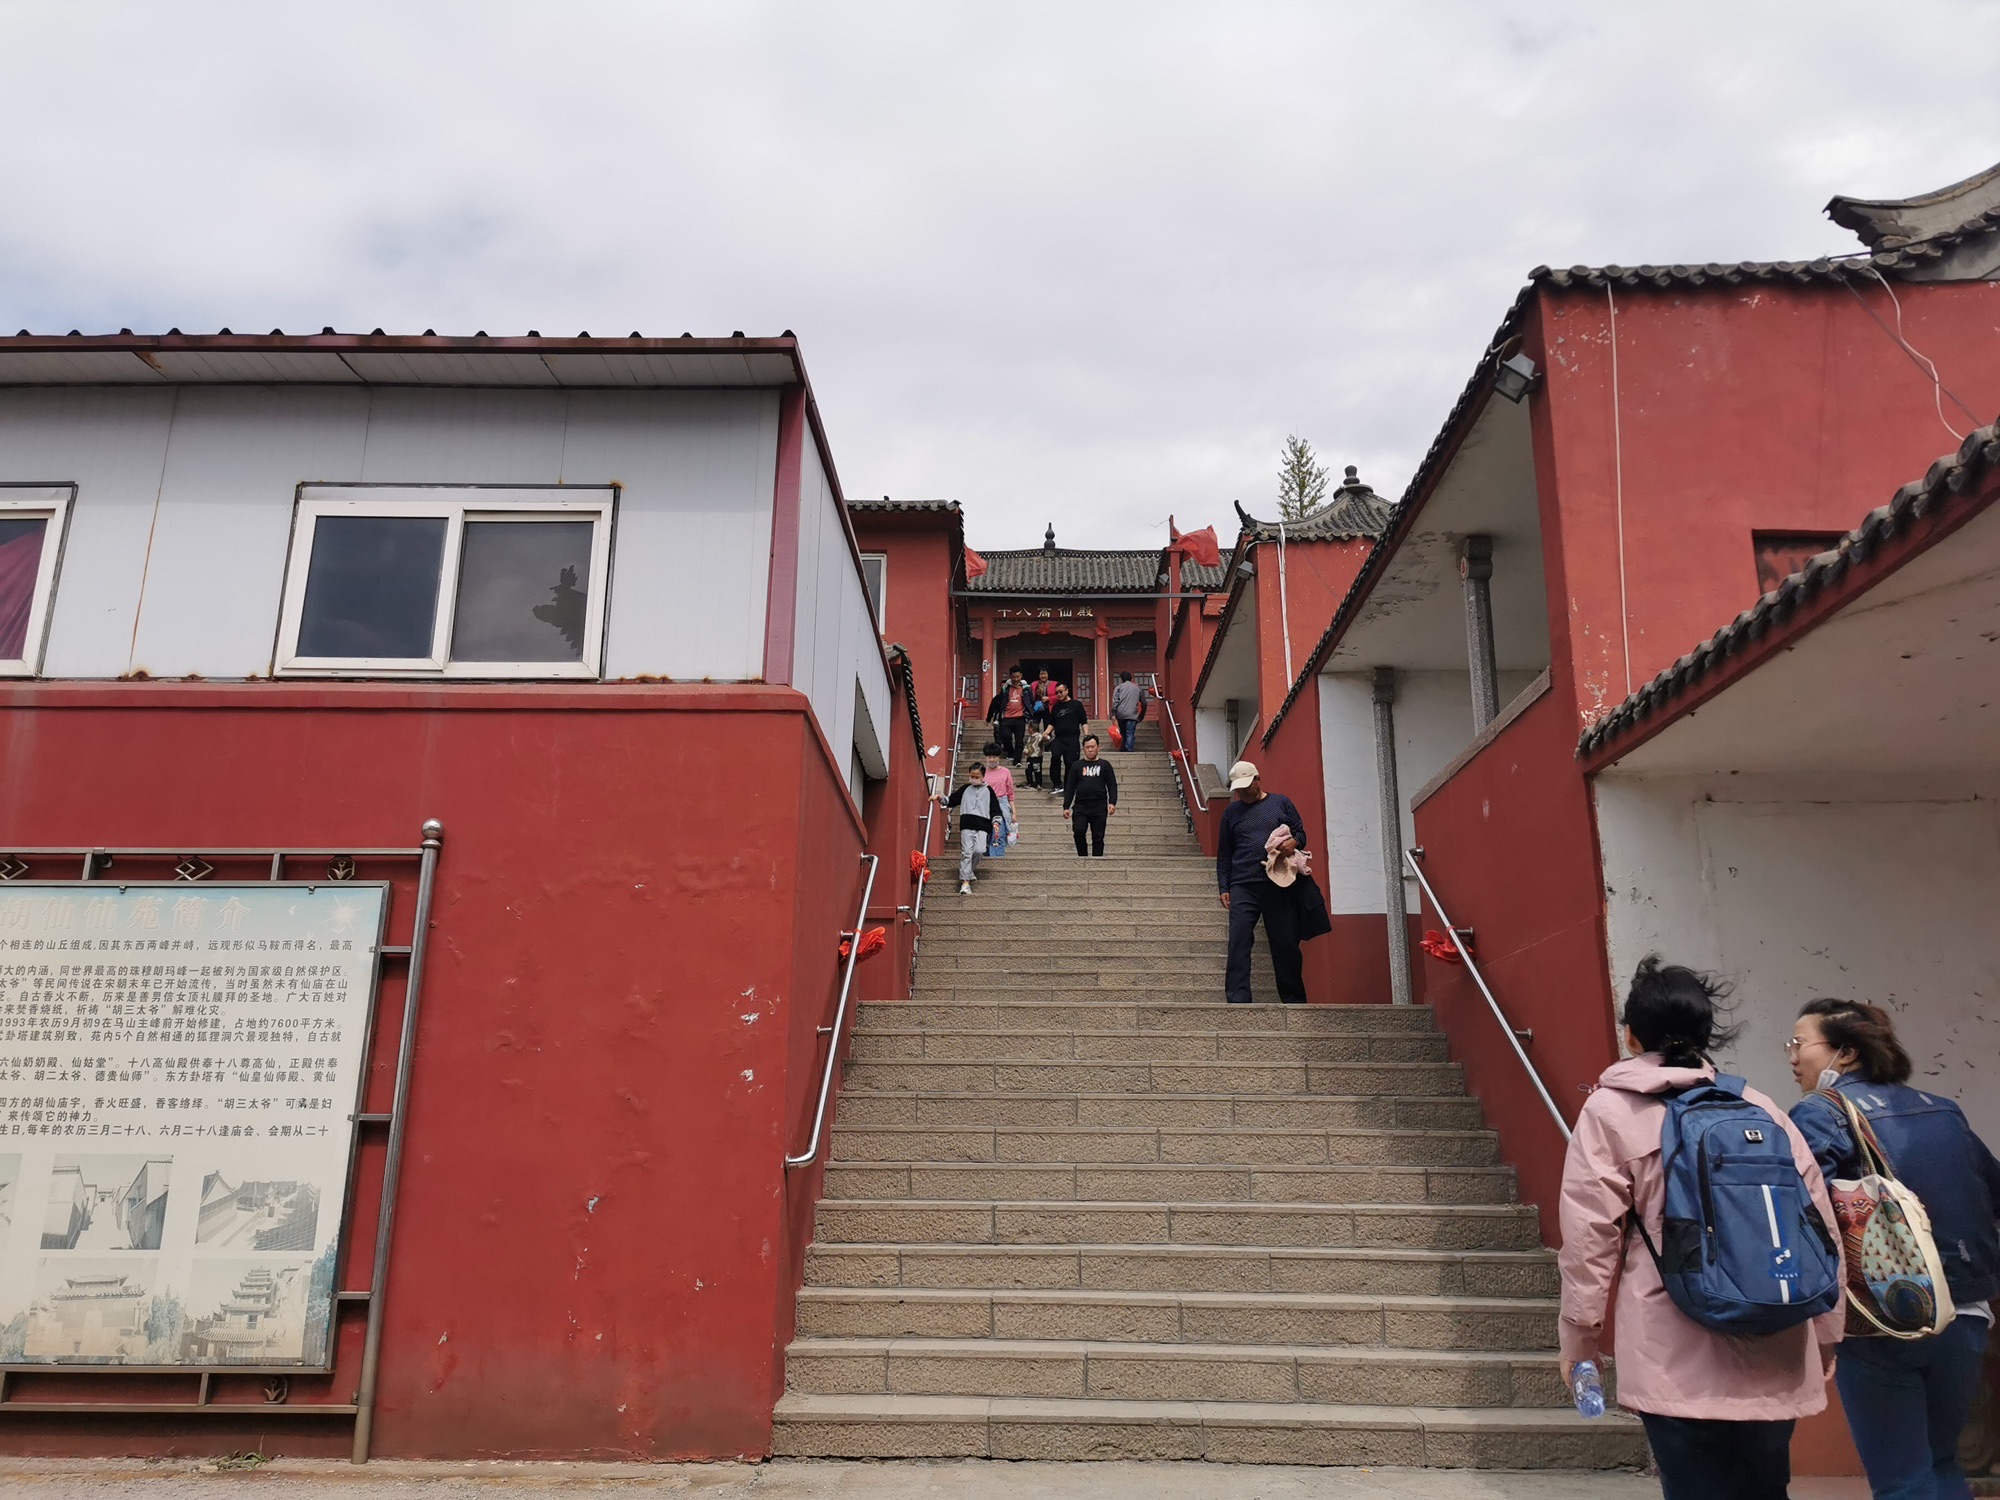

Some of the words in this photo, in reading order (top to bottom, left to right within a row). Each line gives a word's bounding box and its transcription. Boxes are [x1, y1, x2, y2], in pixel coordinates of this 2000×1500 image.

[997, 606, 1093, 618] 十八高仙殿
[0, 895, 251, 931] 胡仙仙苑简介
[0, 1004, 226, 1016] 来焚香烧纸，祈祷“胡三太爷”解难化灾。
[0, 1030, 342, 1042] 卦塔建筑别致，苑内5个自然相通的狐狸洞穴景观独特，自古就
